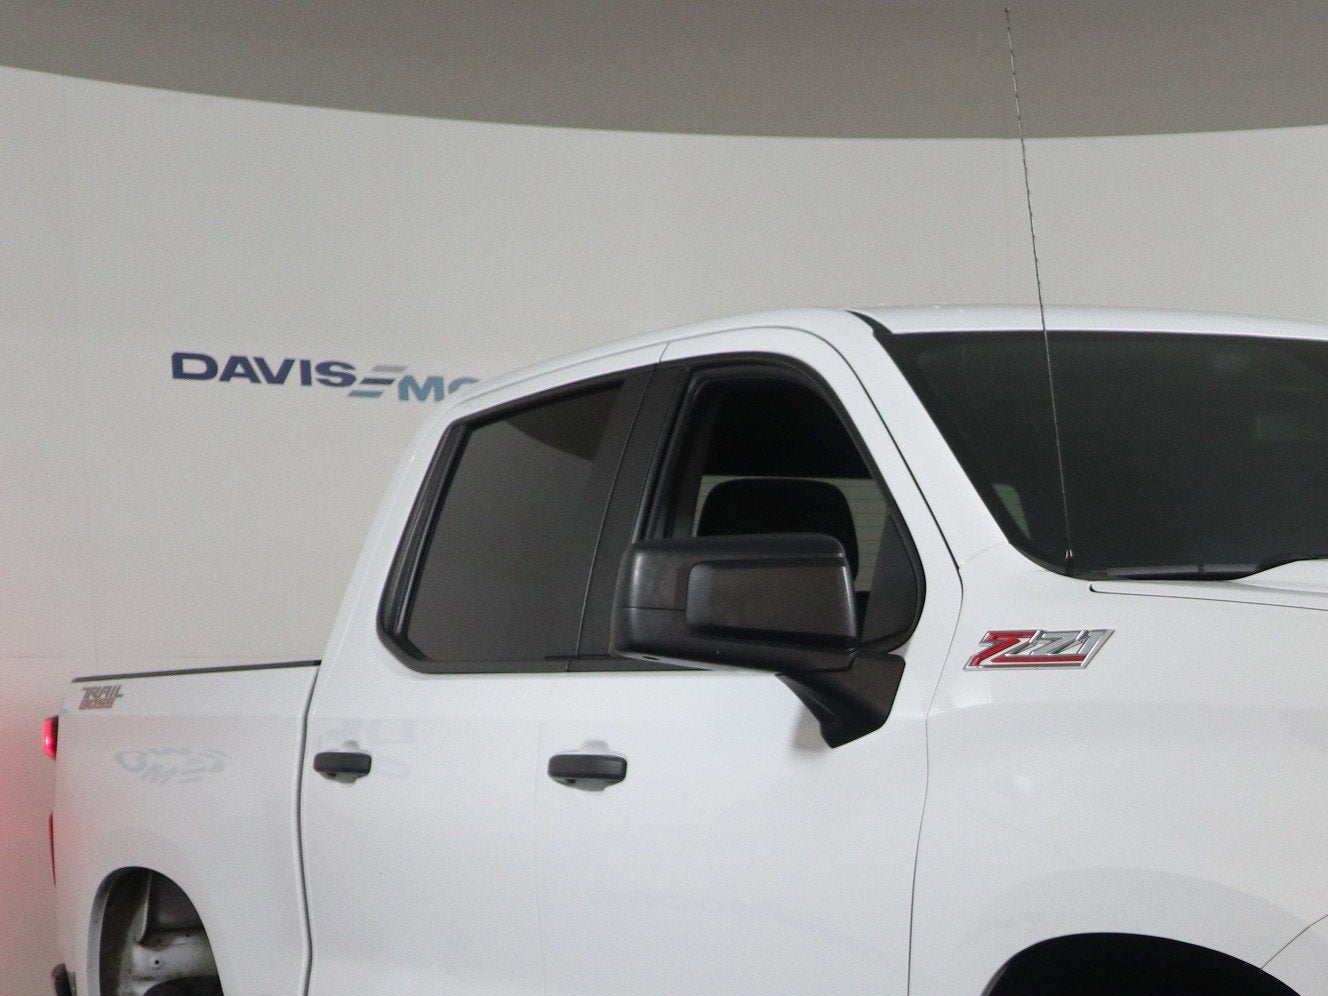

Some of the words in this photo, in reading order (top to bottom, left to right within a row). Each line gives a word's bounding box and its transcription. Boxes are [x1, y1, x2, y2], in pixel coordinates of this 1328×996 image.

[171, 351, 356, 388] DAVIS
[962, 628, 1115, 671] Z71
[82, 685, 124, 701] TRAIL
